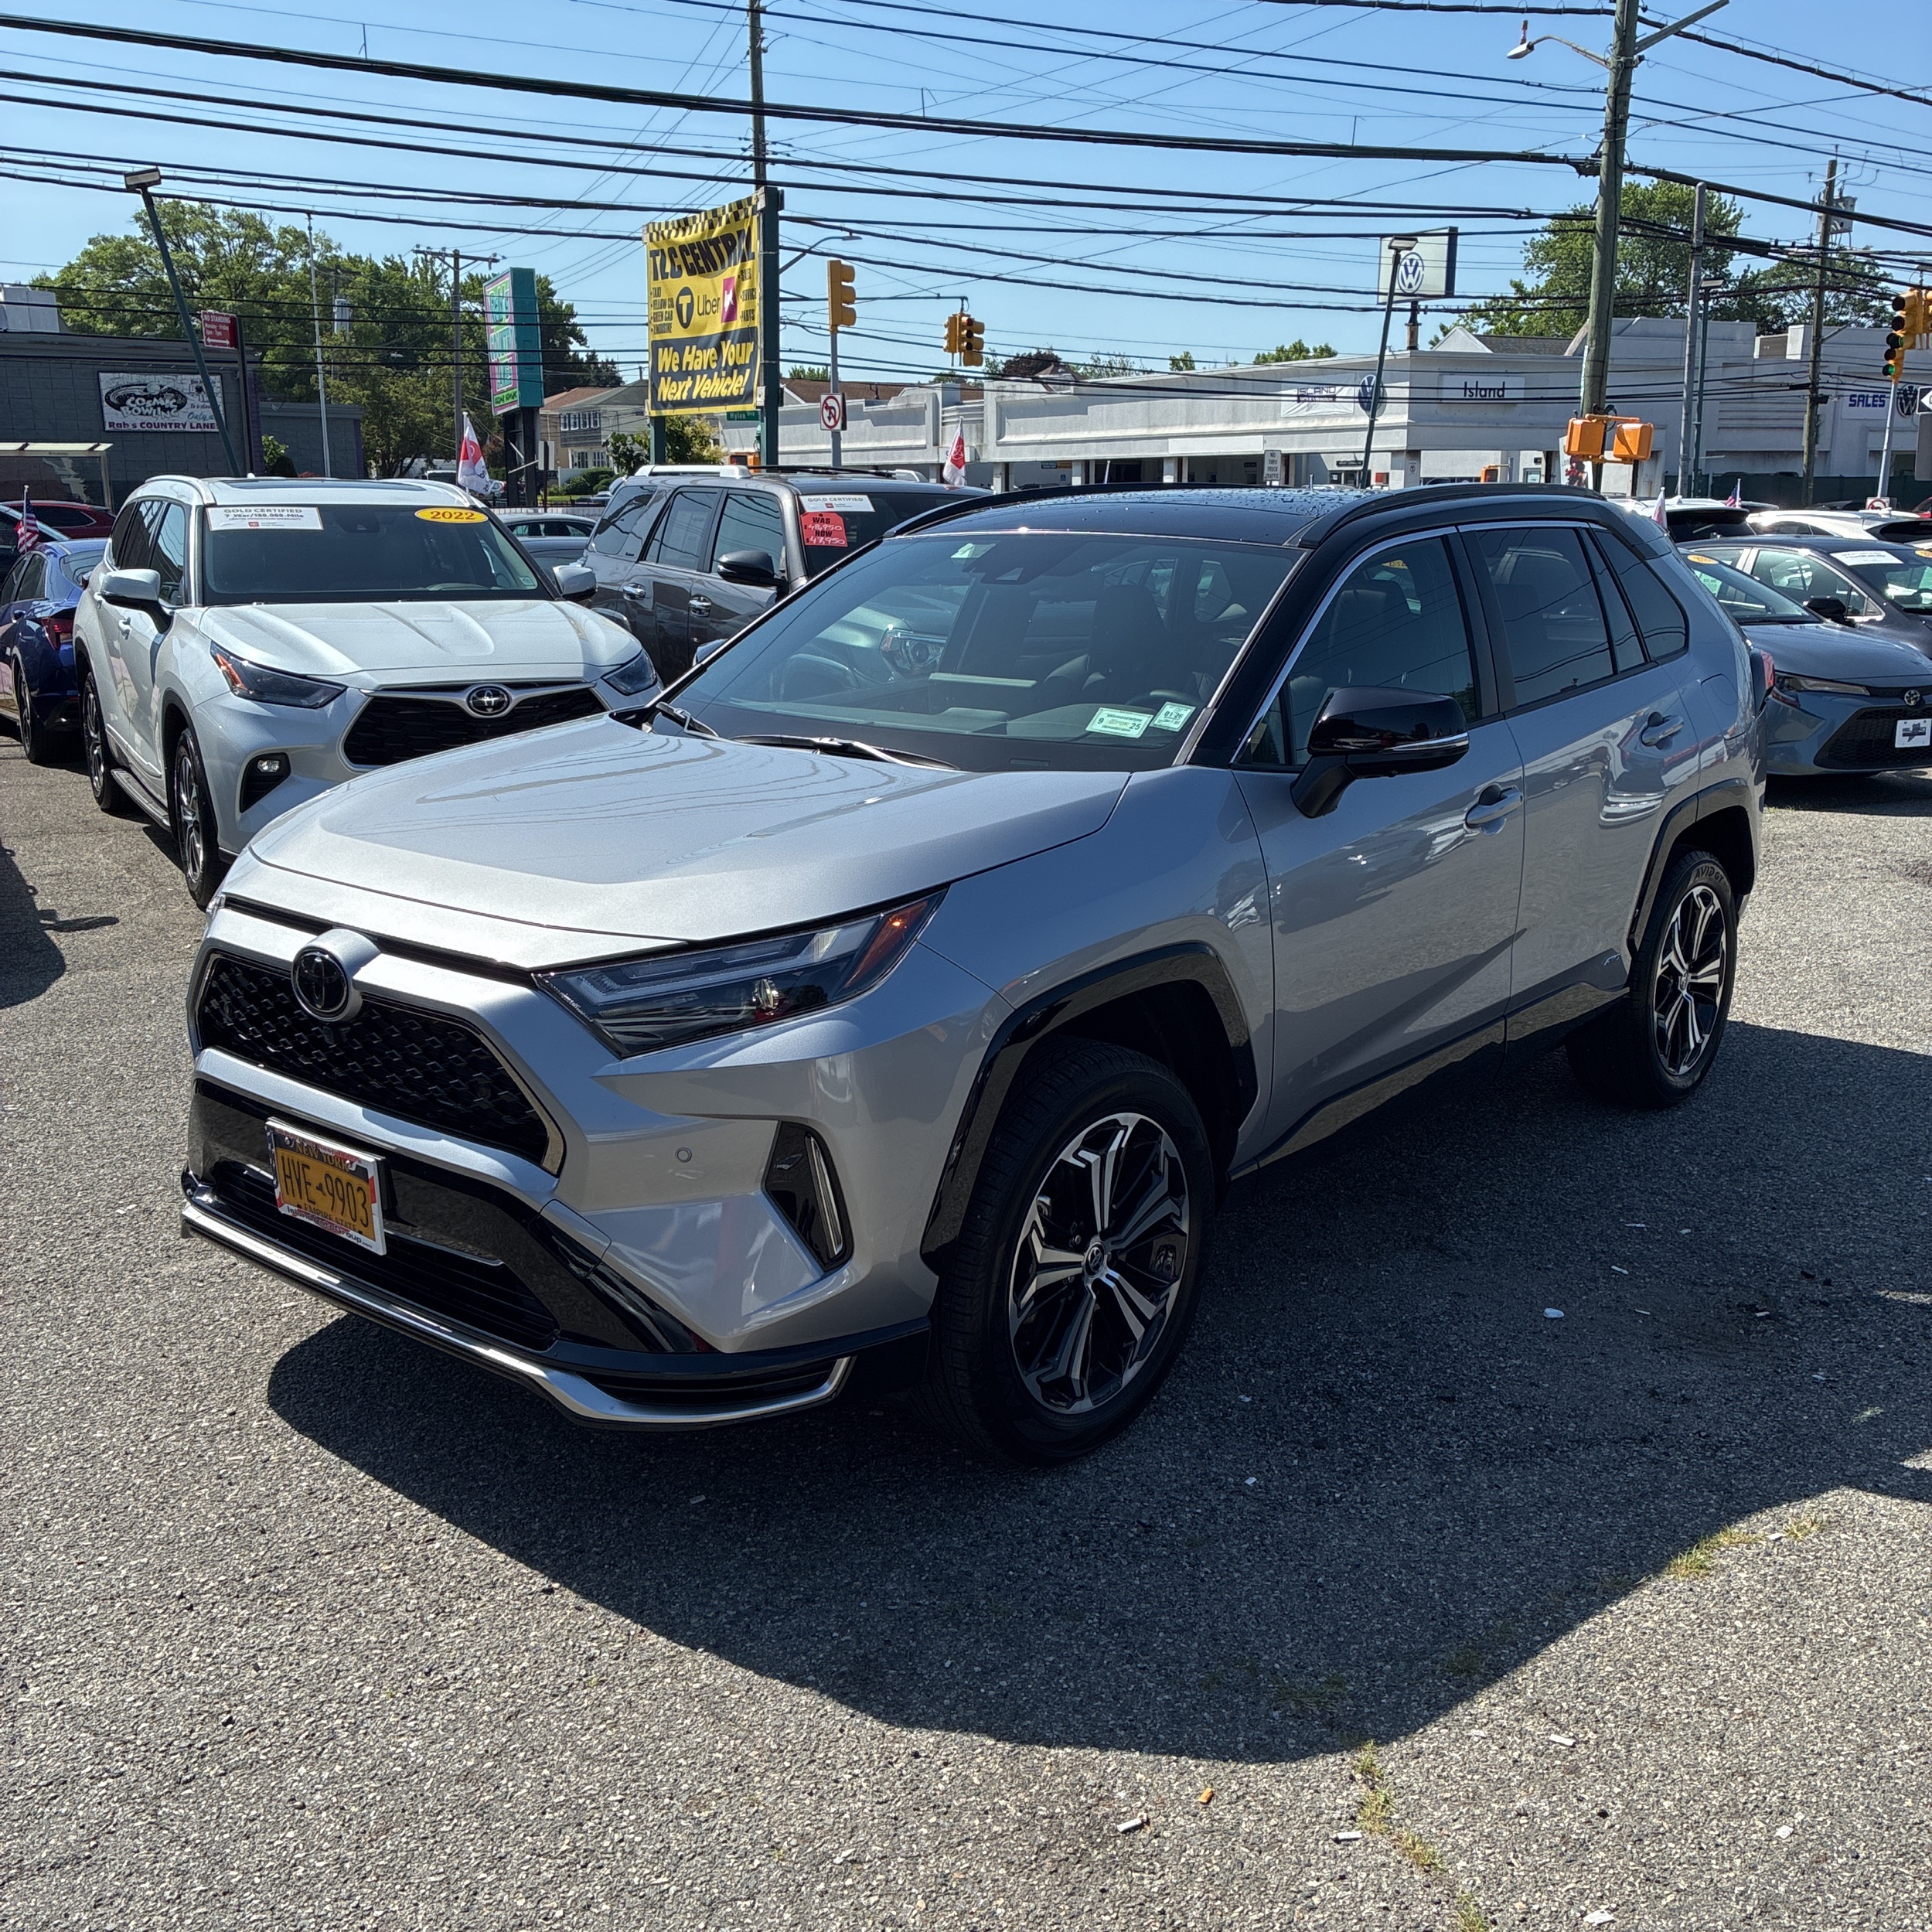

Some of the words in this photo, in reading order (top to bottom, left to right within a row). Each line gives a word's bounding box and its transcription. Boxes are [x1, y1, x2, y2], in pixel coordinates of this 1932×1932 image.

[649, 246, 683, 281] TLC
[679, 226, 755, 277] CENTRAL
[697, 295, 720, 316] Uber
[658, 346, 680, 373] We
[682, 345, 717, 371] Have
[721, 339, 754, 367] Your
[657, 376, 693, 401] Next
[692, 369, 751, 399] Vehicle!
[1464, 380, 1505, 397] Island
[121, 405, 178, 419] BOWLING
[126, 394, 177, 408] COSMIC
[1849, 394, 1886, 407] SALES
[431, 511, 475, 520] 2022
[295, 1143, 319, 1160] NEW
[322, 1154, 350, 1171] YORK
[324, 1174, 369, 1228] 9903
[304, 1203, 333, 1221] EMPIRE
[336, 1215, 356, 1231] STATE
